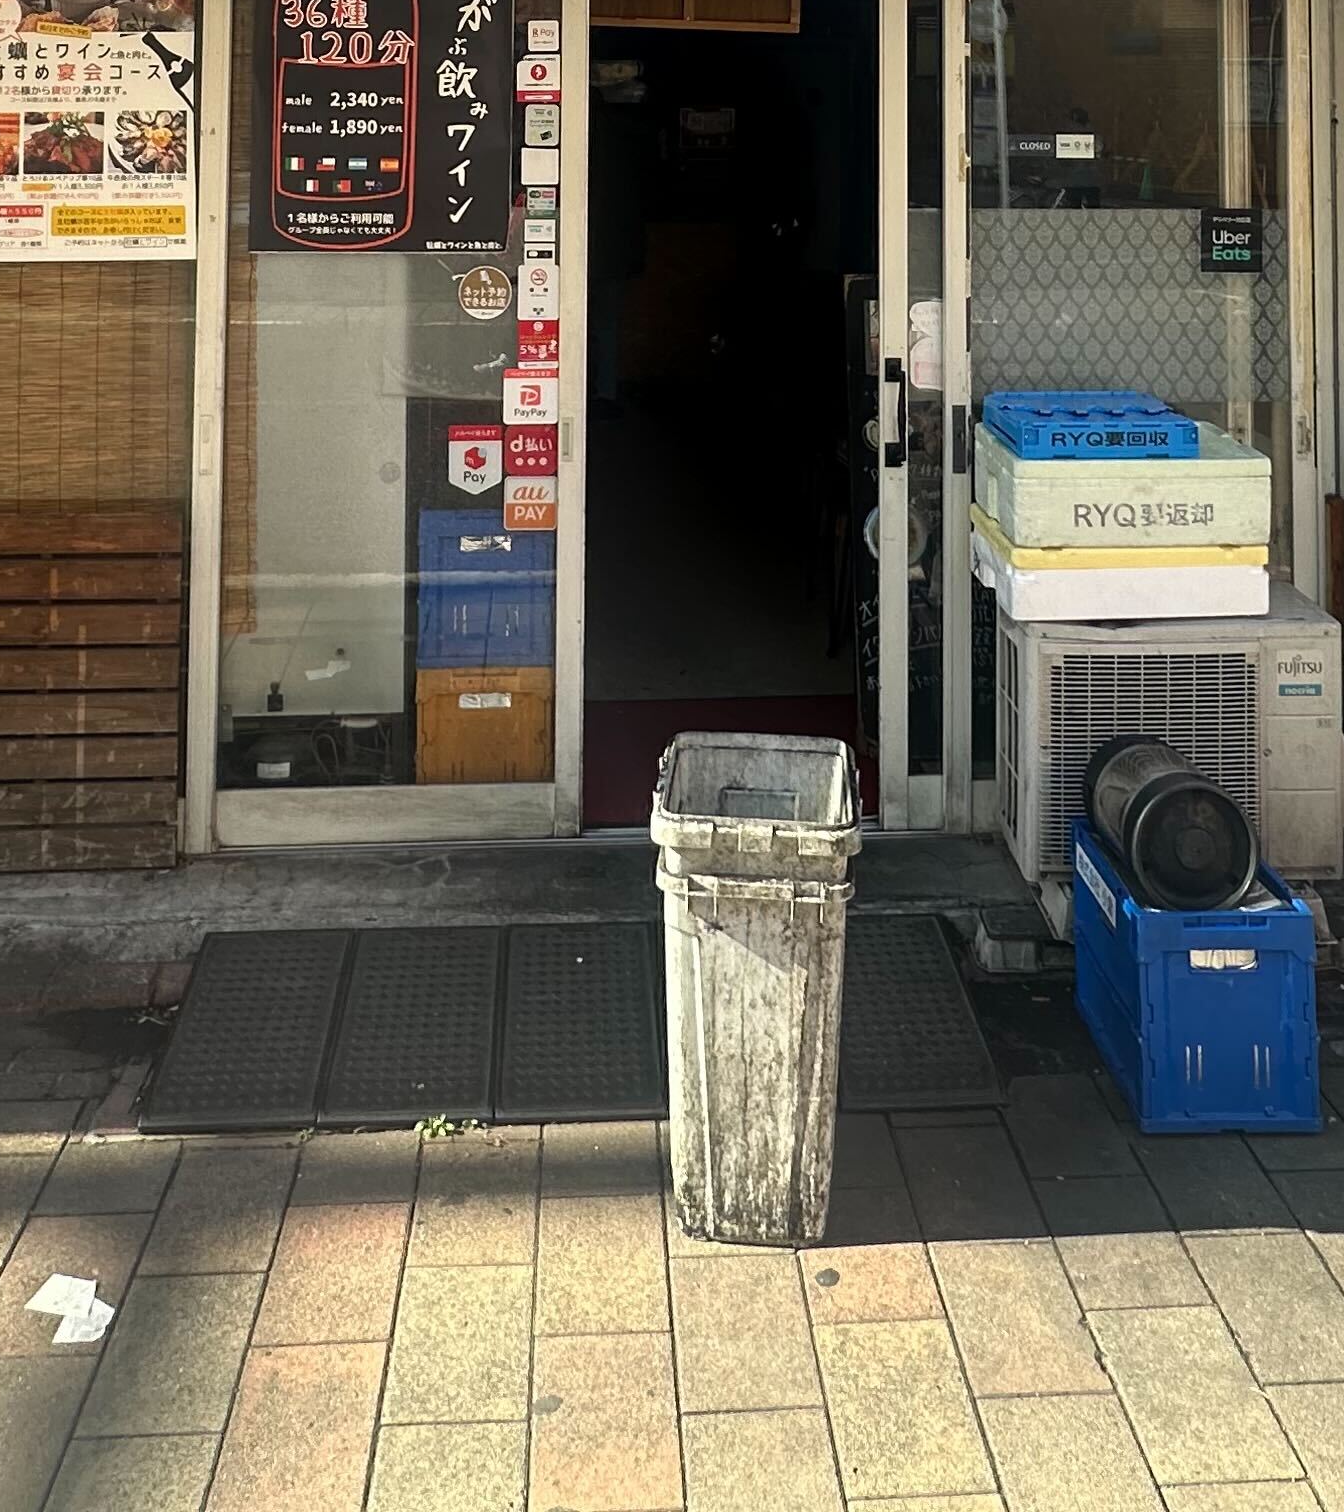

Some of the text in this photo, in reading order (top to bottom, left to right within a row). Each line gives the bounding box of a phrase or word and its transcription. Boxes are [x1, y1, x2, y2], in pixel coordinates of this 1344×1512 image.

[296, 30, 415, 65] 120分
[285, 91, 404, 110] male 2,340 yen
[281, 118, 404, 138] female 1,890 yen
[1019, 141, 1051, 151] CLOSED
[287, 213, 395, 225] 1名様からご利用可能
[1212, 229, 1251, 244] Uber
[1212, 246, 1251, 261] Eats
[463, 286, 507, 297] ネット予約
[463, 298, 506, 307] できるお店
[514, 408, 547, 417] PayPay
[509, 434, 553, 453] d払い
[1051, 431, 1170, 448] RYQ要回収
[463, 471, 486, 484] Pay
[513, 485, 549, 501] au
[514, 505, 547, 521] PAY
[1278, 654, 1322, 677] FUJITSU
